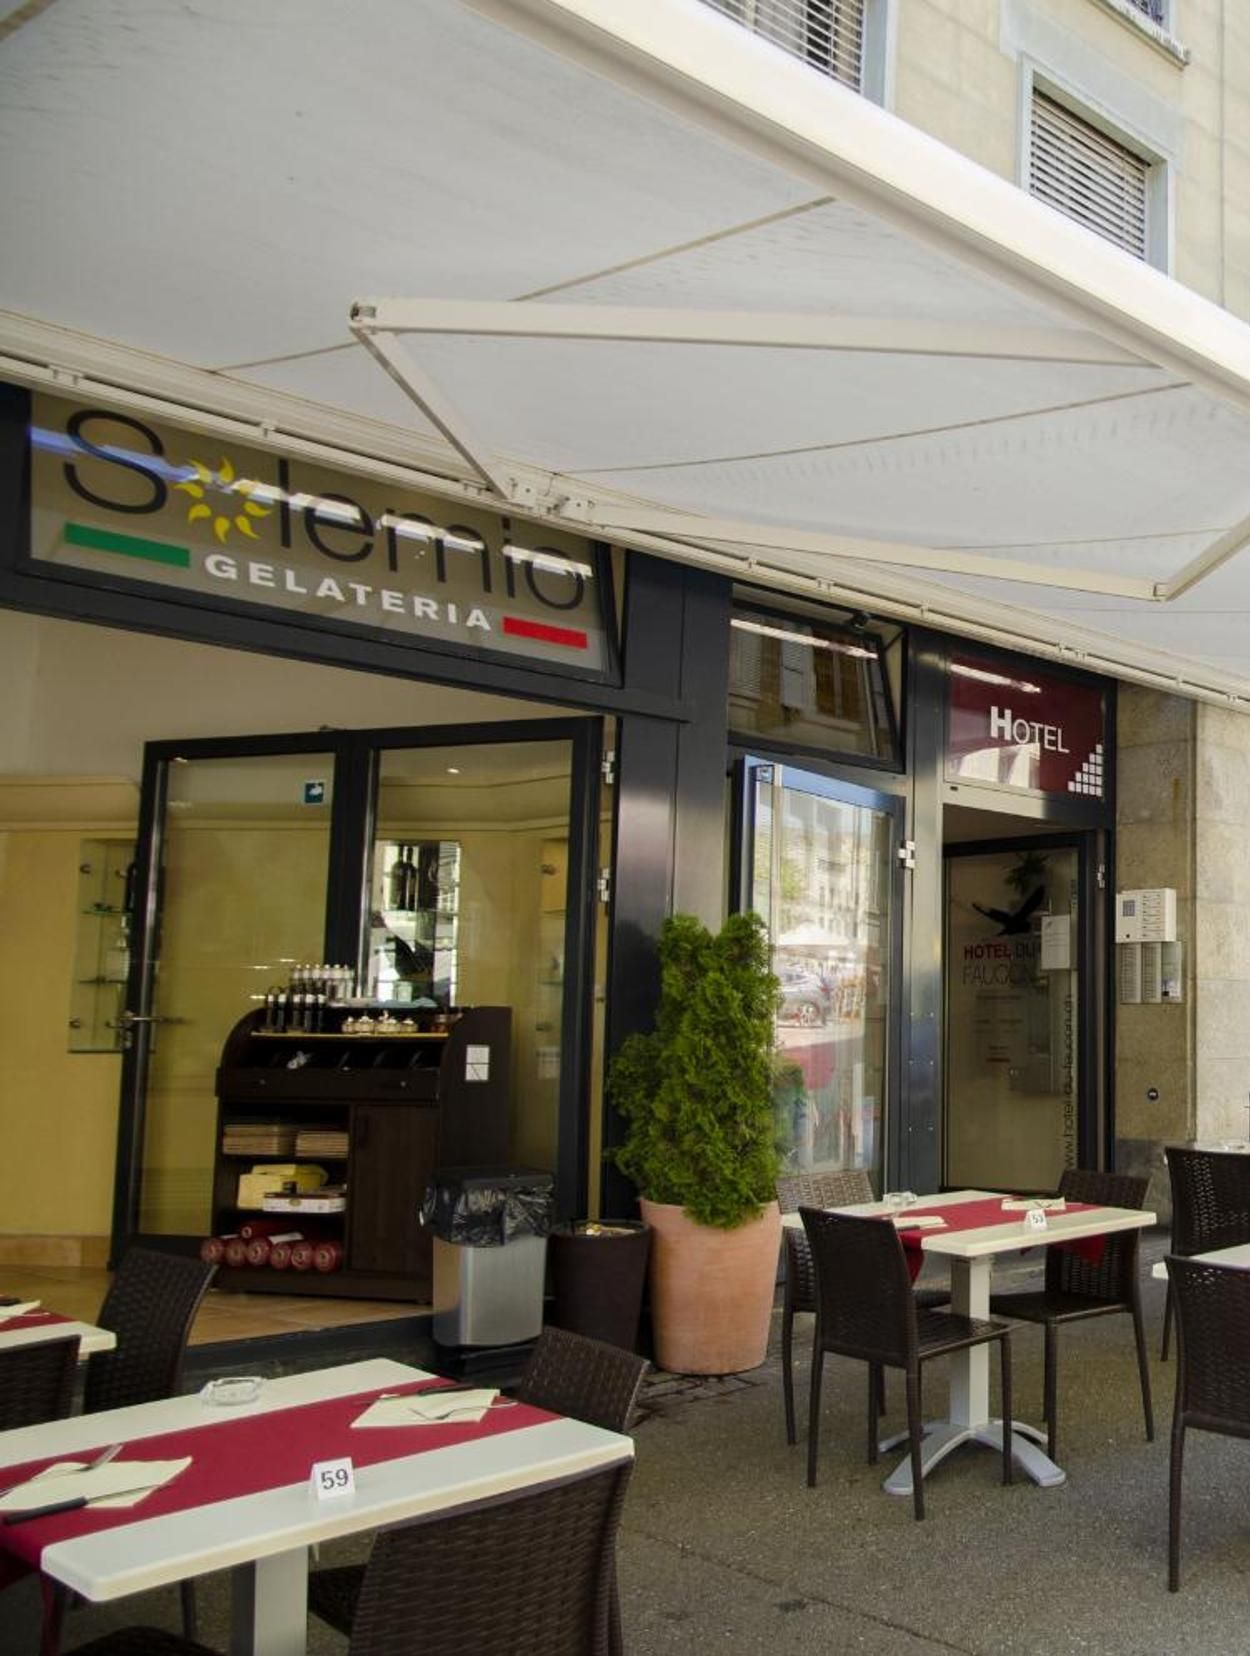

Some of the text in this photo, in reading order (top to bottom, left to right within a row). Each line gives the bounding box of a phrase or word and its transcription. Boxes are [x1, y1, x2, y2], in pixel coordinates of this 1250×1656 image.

[205, 554, 491, 631] GELATERIA
[990, 706, 1070, 753] HOTEL
[963, 943, 1012, 960] HOTEL
[321, 1468, 348, 1490] 59
